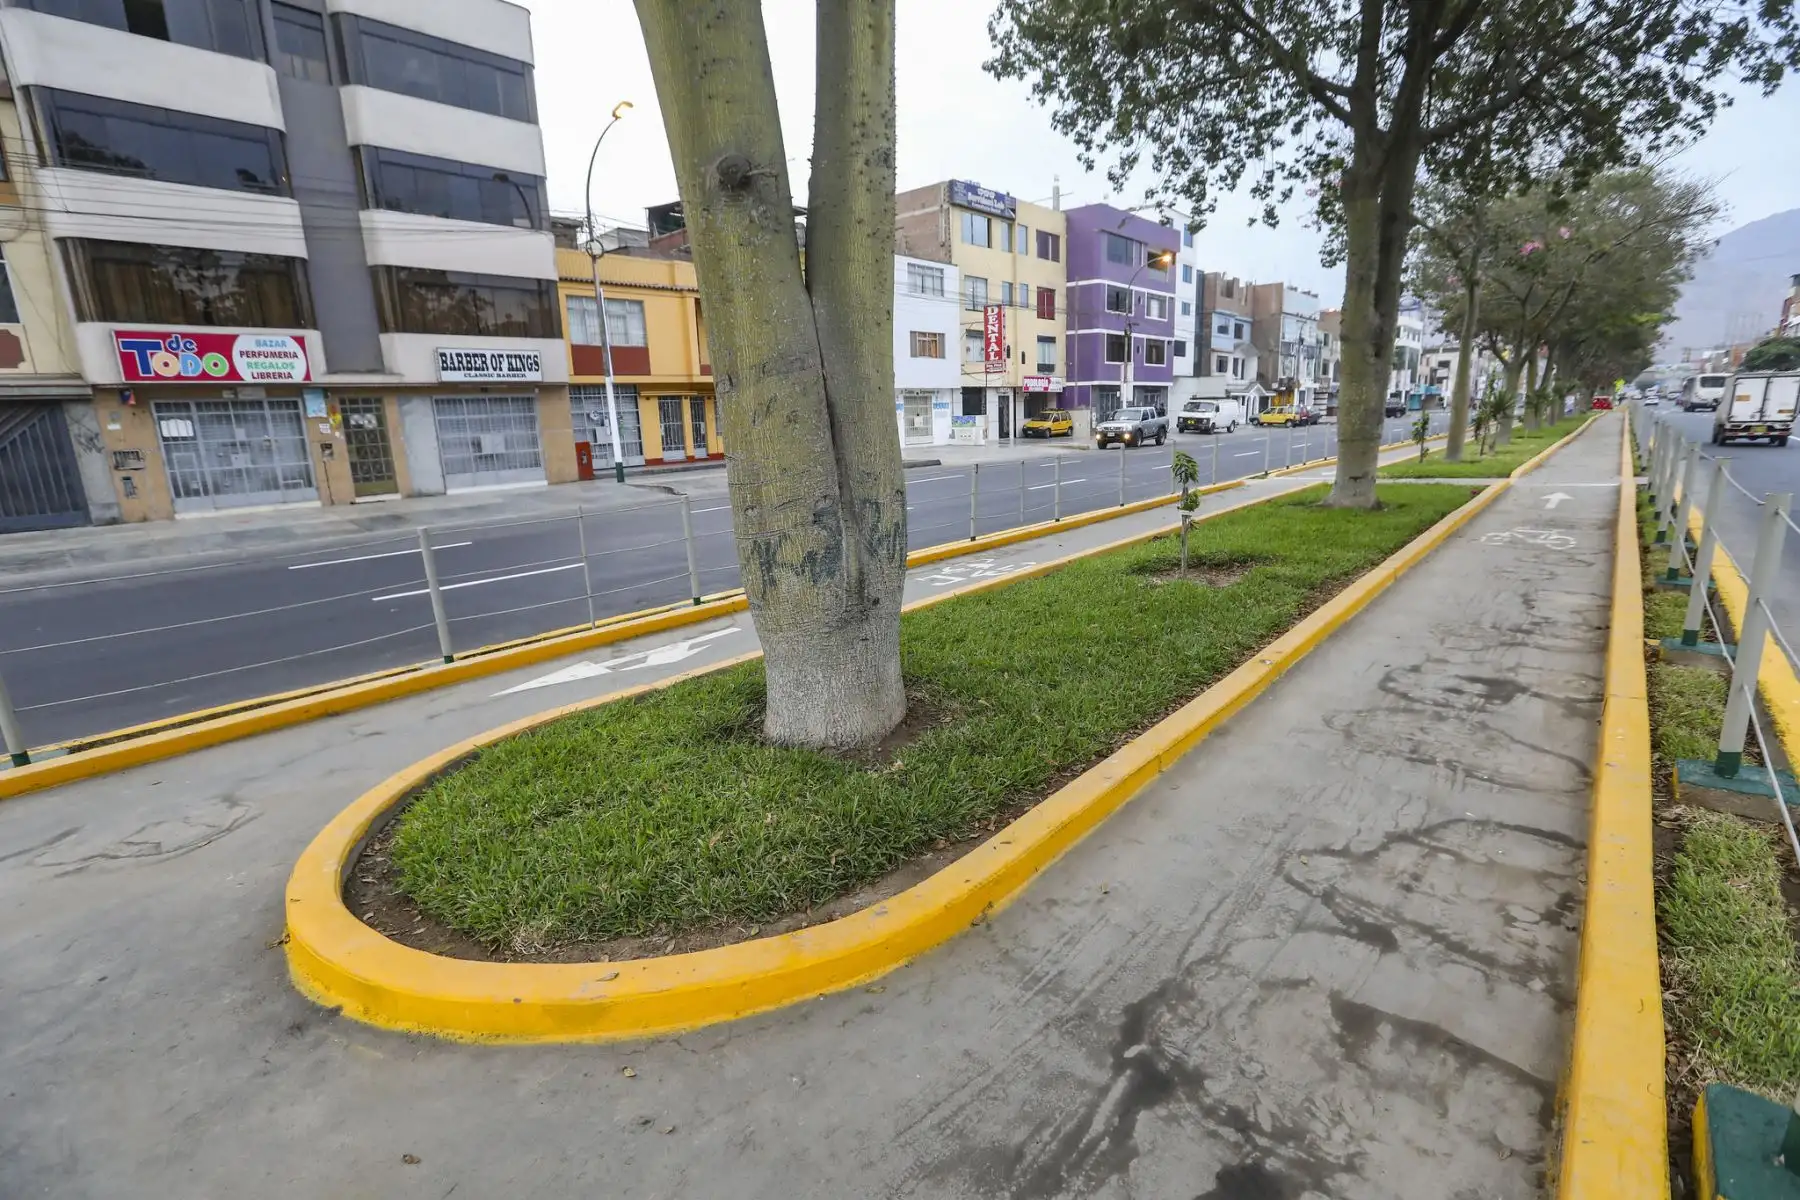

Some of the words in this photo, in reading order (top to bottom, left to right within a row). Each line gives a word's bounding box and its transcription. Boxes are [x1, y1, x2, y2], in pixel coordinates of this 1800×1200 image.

[986, 306, 1000, 360] DENTAL
[166, 334, 198, 352] de
[255, 339, 287, 348] BAZAR
[239, 350, 298, 360] PERFUMERIA
[246, 361, 296, 370] REGALOS
[439, 352, 489, 371] BARBER
[490, 353, 504, 371] OF
[506, 353, 540, 372] KINGS
[251, 371, 293, 380] LIBRERIA
